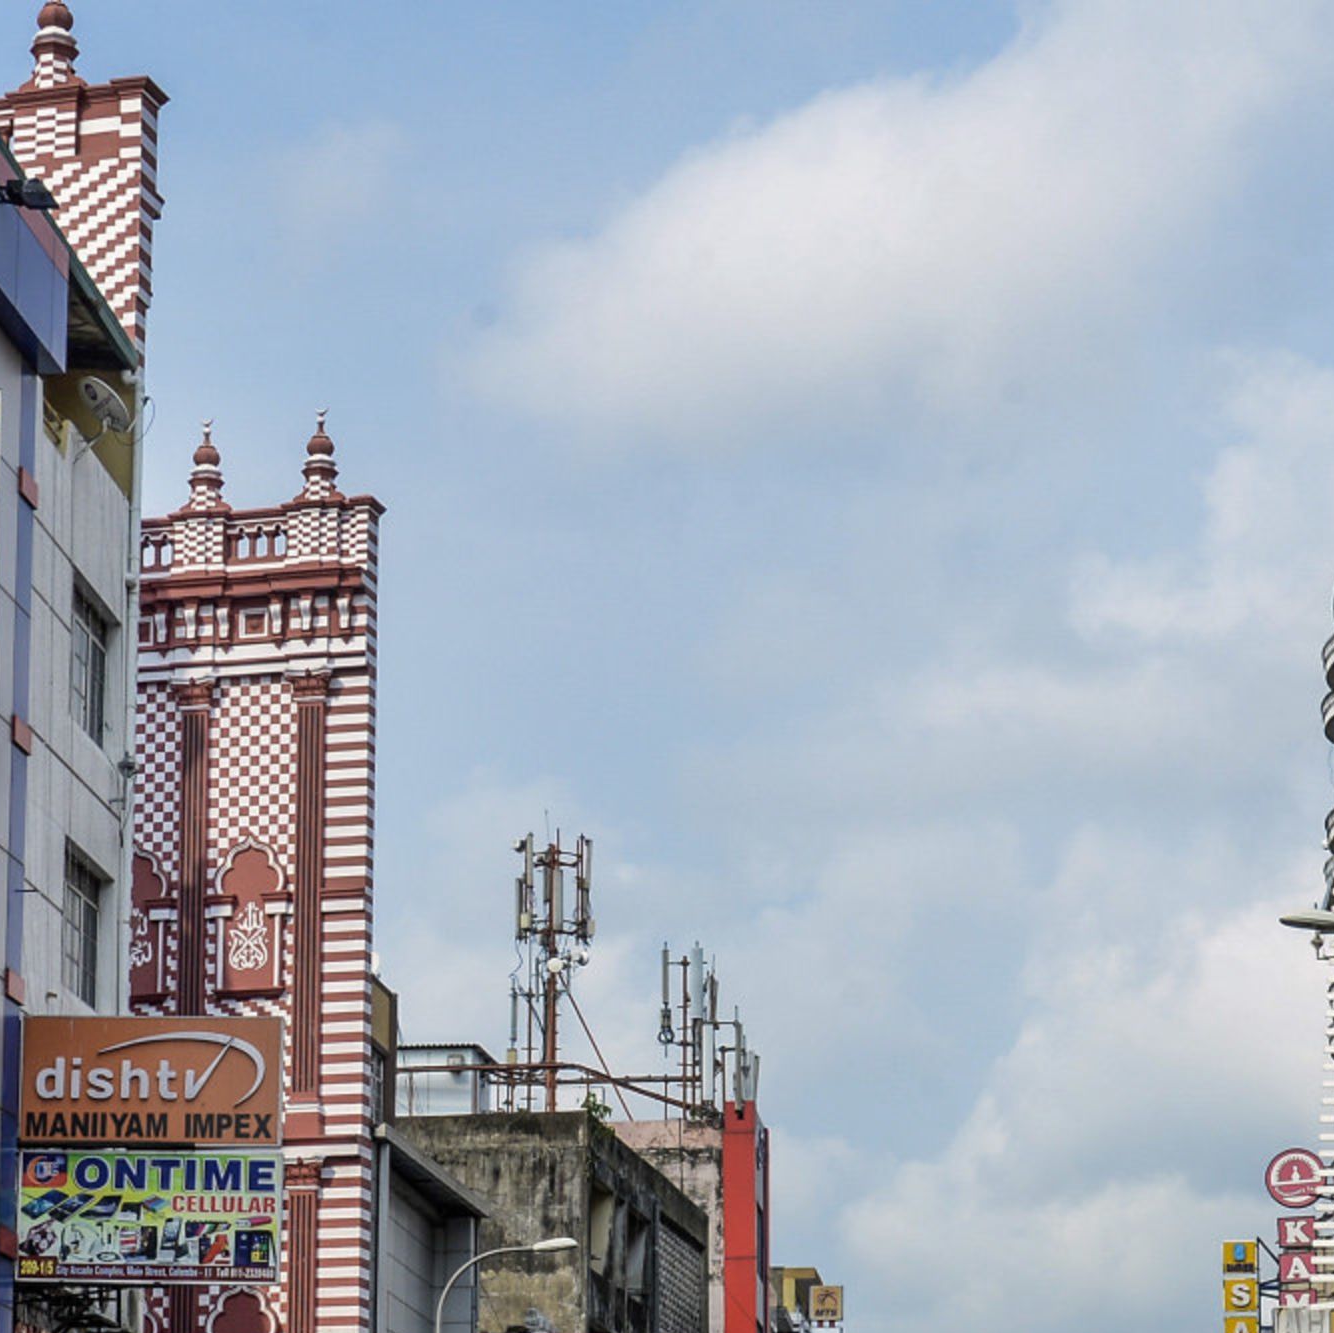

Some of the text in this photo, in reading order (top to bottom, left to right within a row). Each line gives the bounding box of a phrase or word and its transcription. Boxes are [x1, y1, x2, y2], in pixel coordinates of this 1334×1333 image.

[35, 1037, 233, 1101] dishtv
[184, 1113, 273, 1139] IMPEX
[74, 1156, 277, 1193] ONTIME
[170, 1195, 277, 1213] CELLULAR
